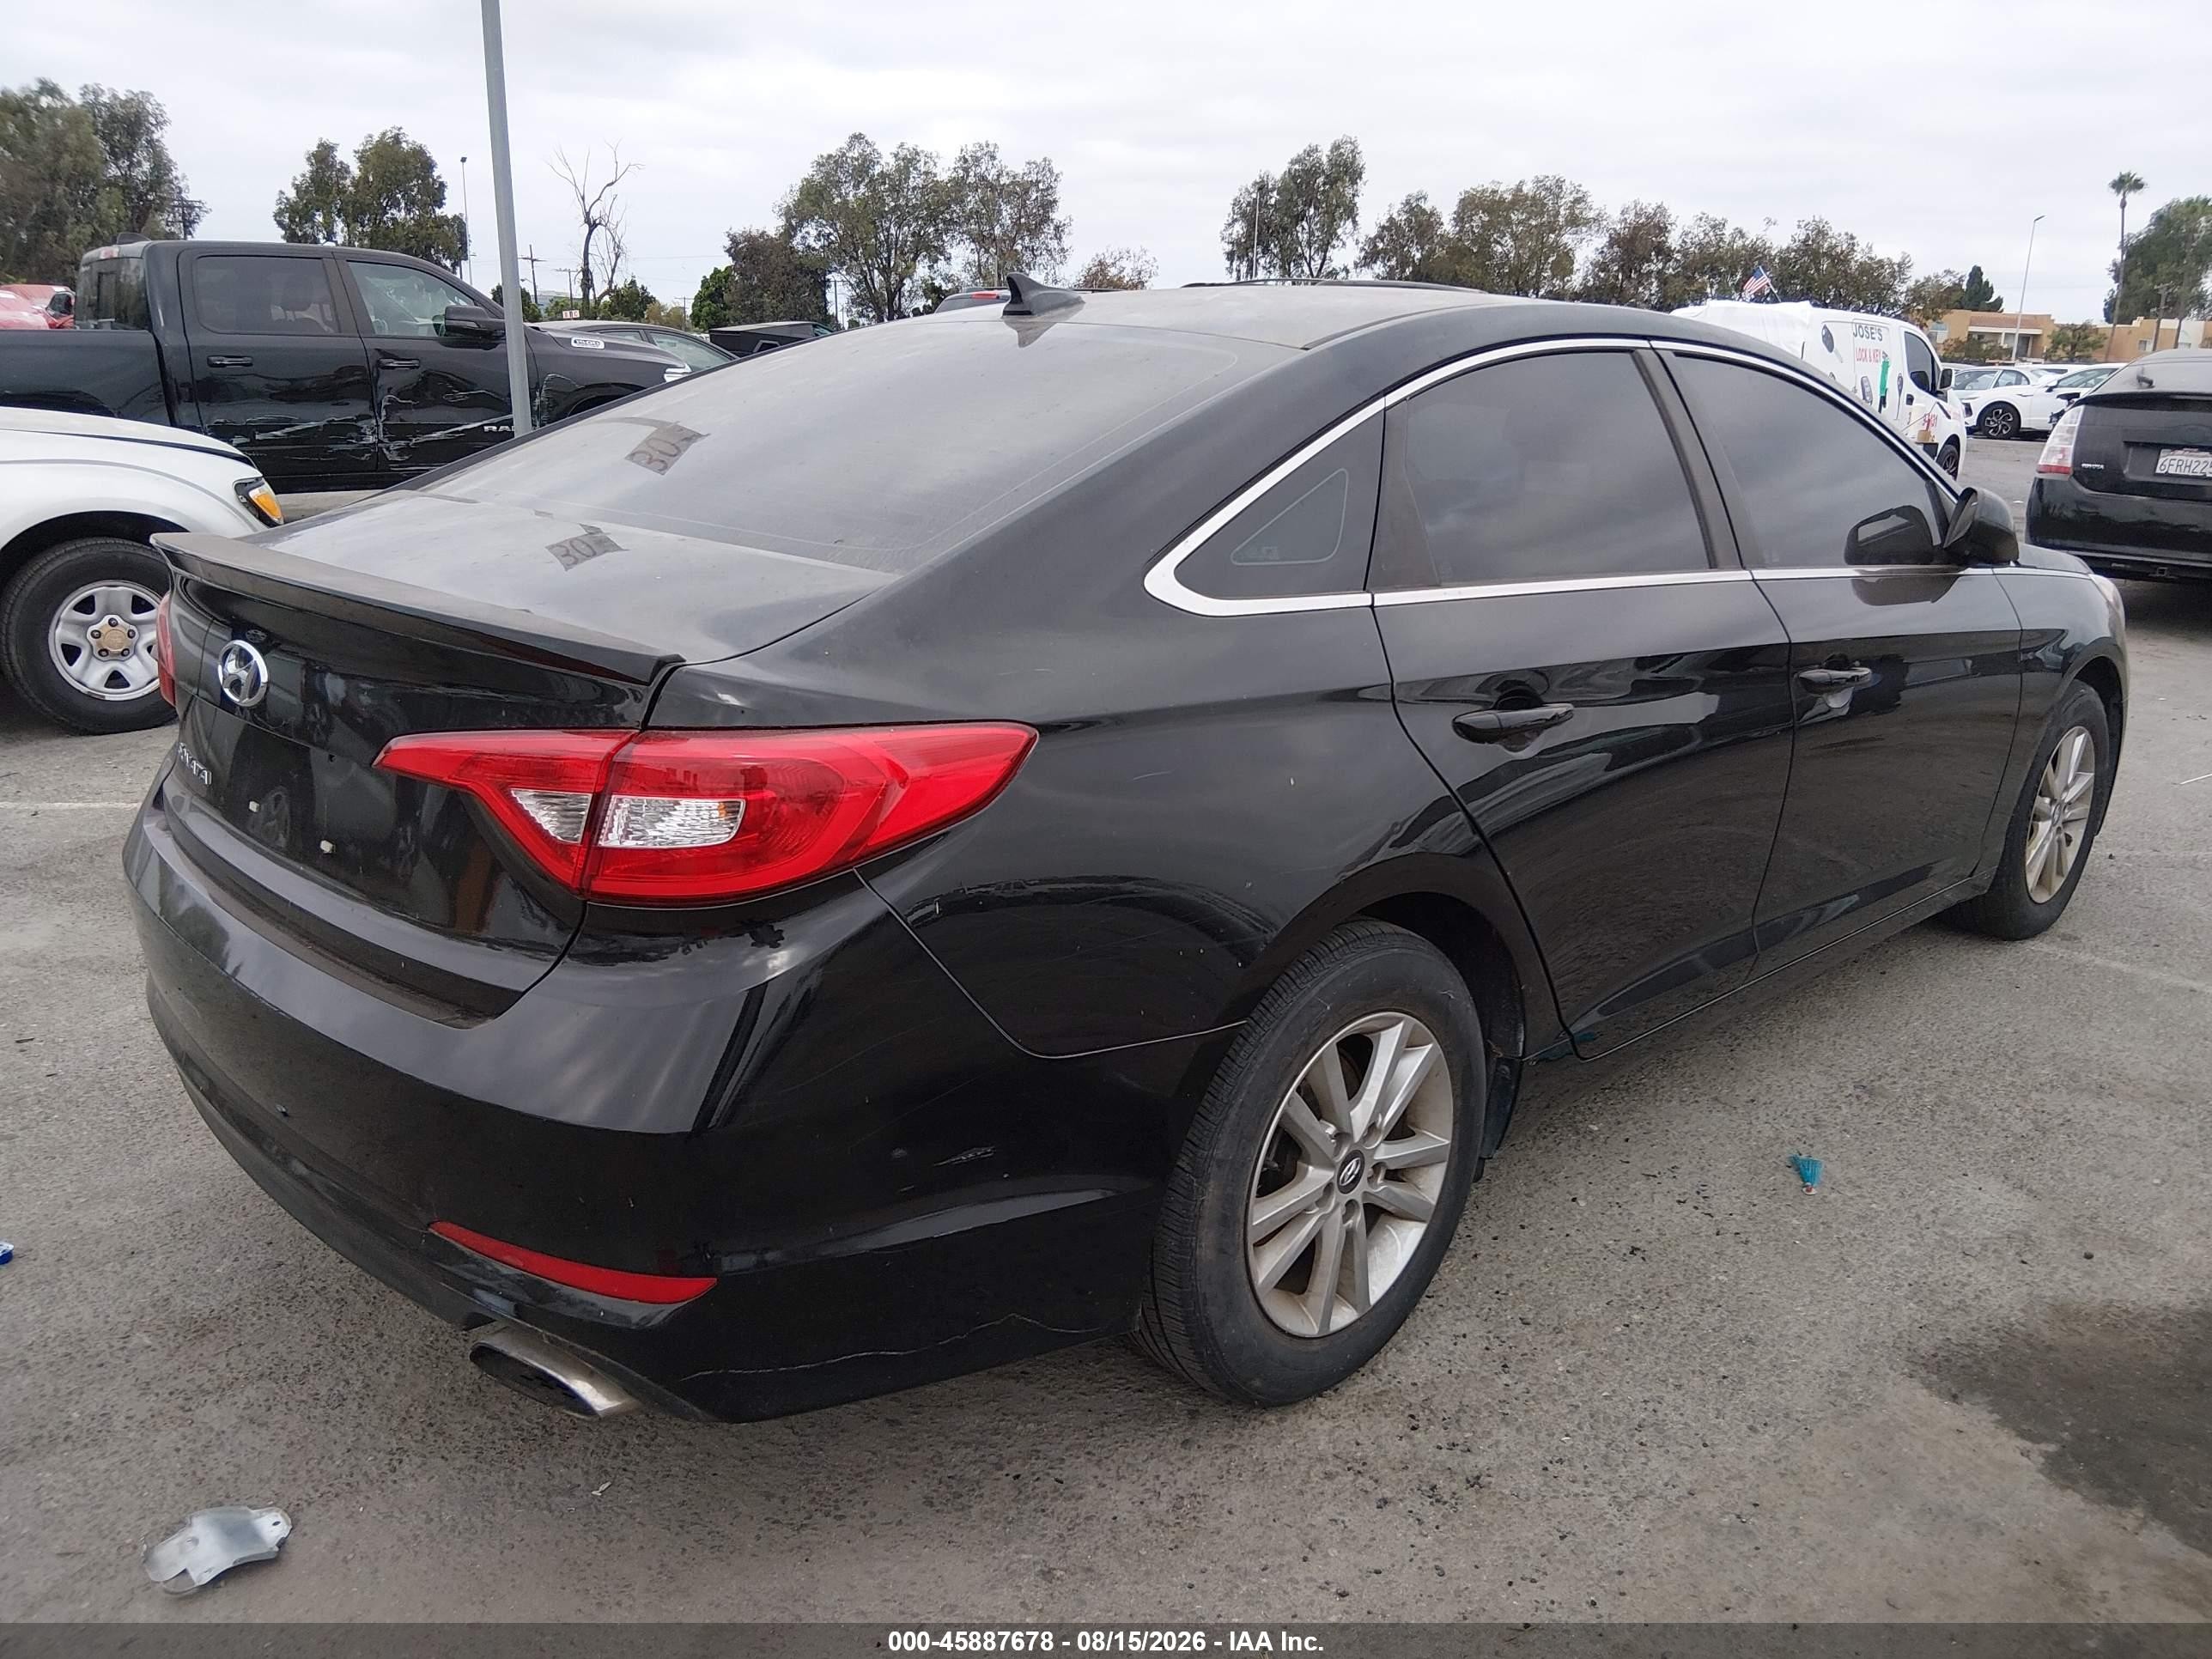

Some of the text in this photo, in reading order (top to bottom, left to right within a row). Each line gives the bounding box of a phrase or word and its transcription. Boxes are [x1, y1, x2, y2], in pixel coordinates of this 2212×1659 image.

[1852, 323, 1883, 342] JOSE'S
[1855, 347, 1868, 362] LOCK
[1873, 349, 1881, 363] KEY
